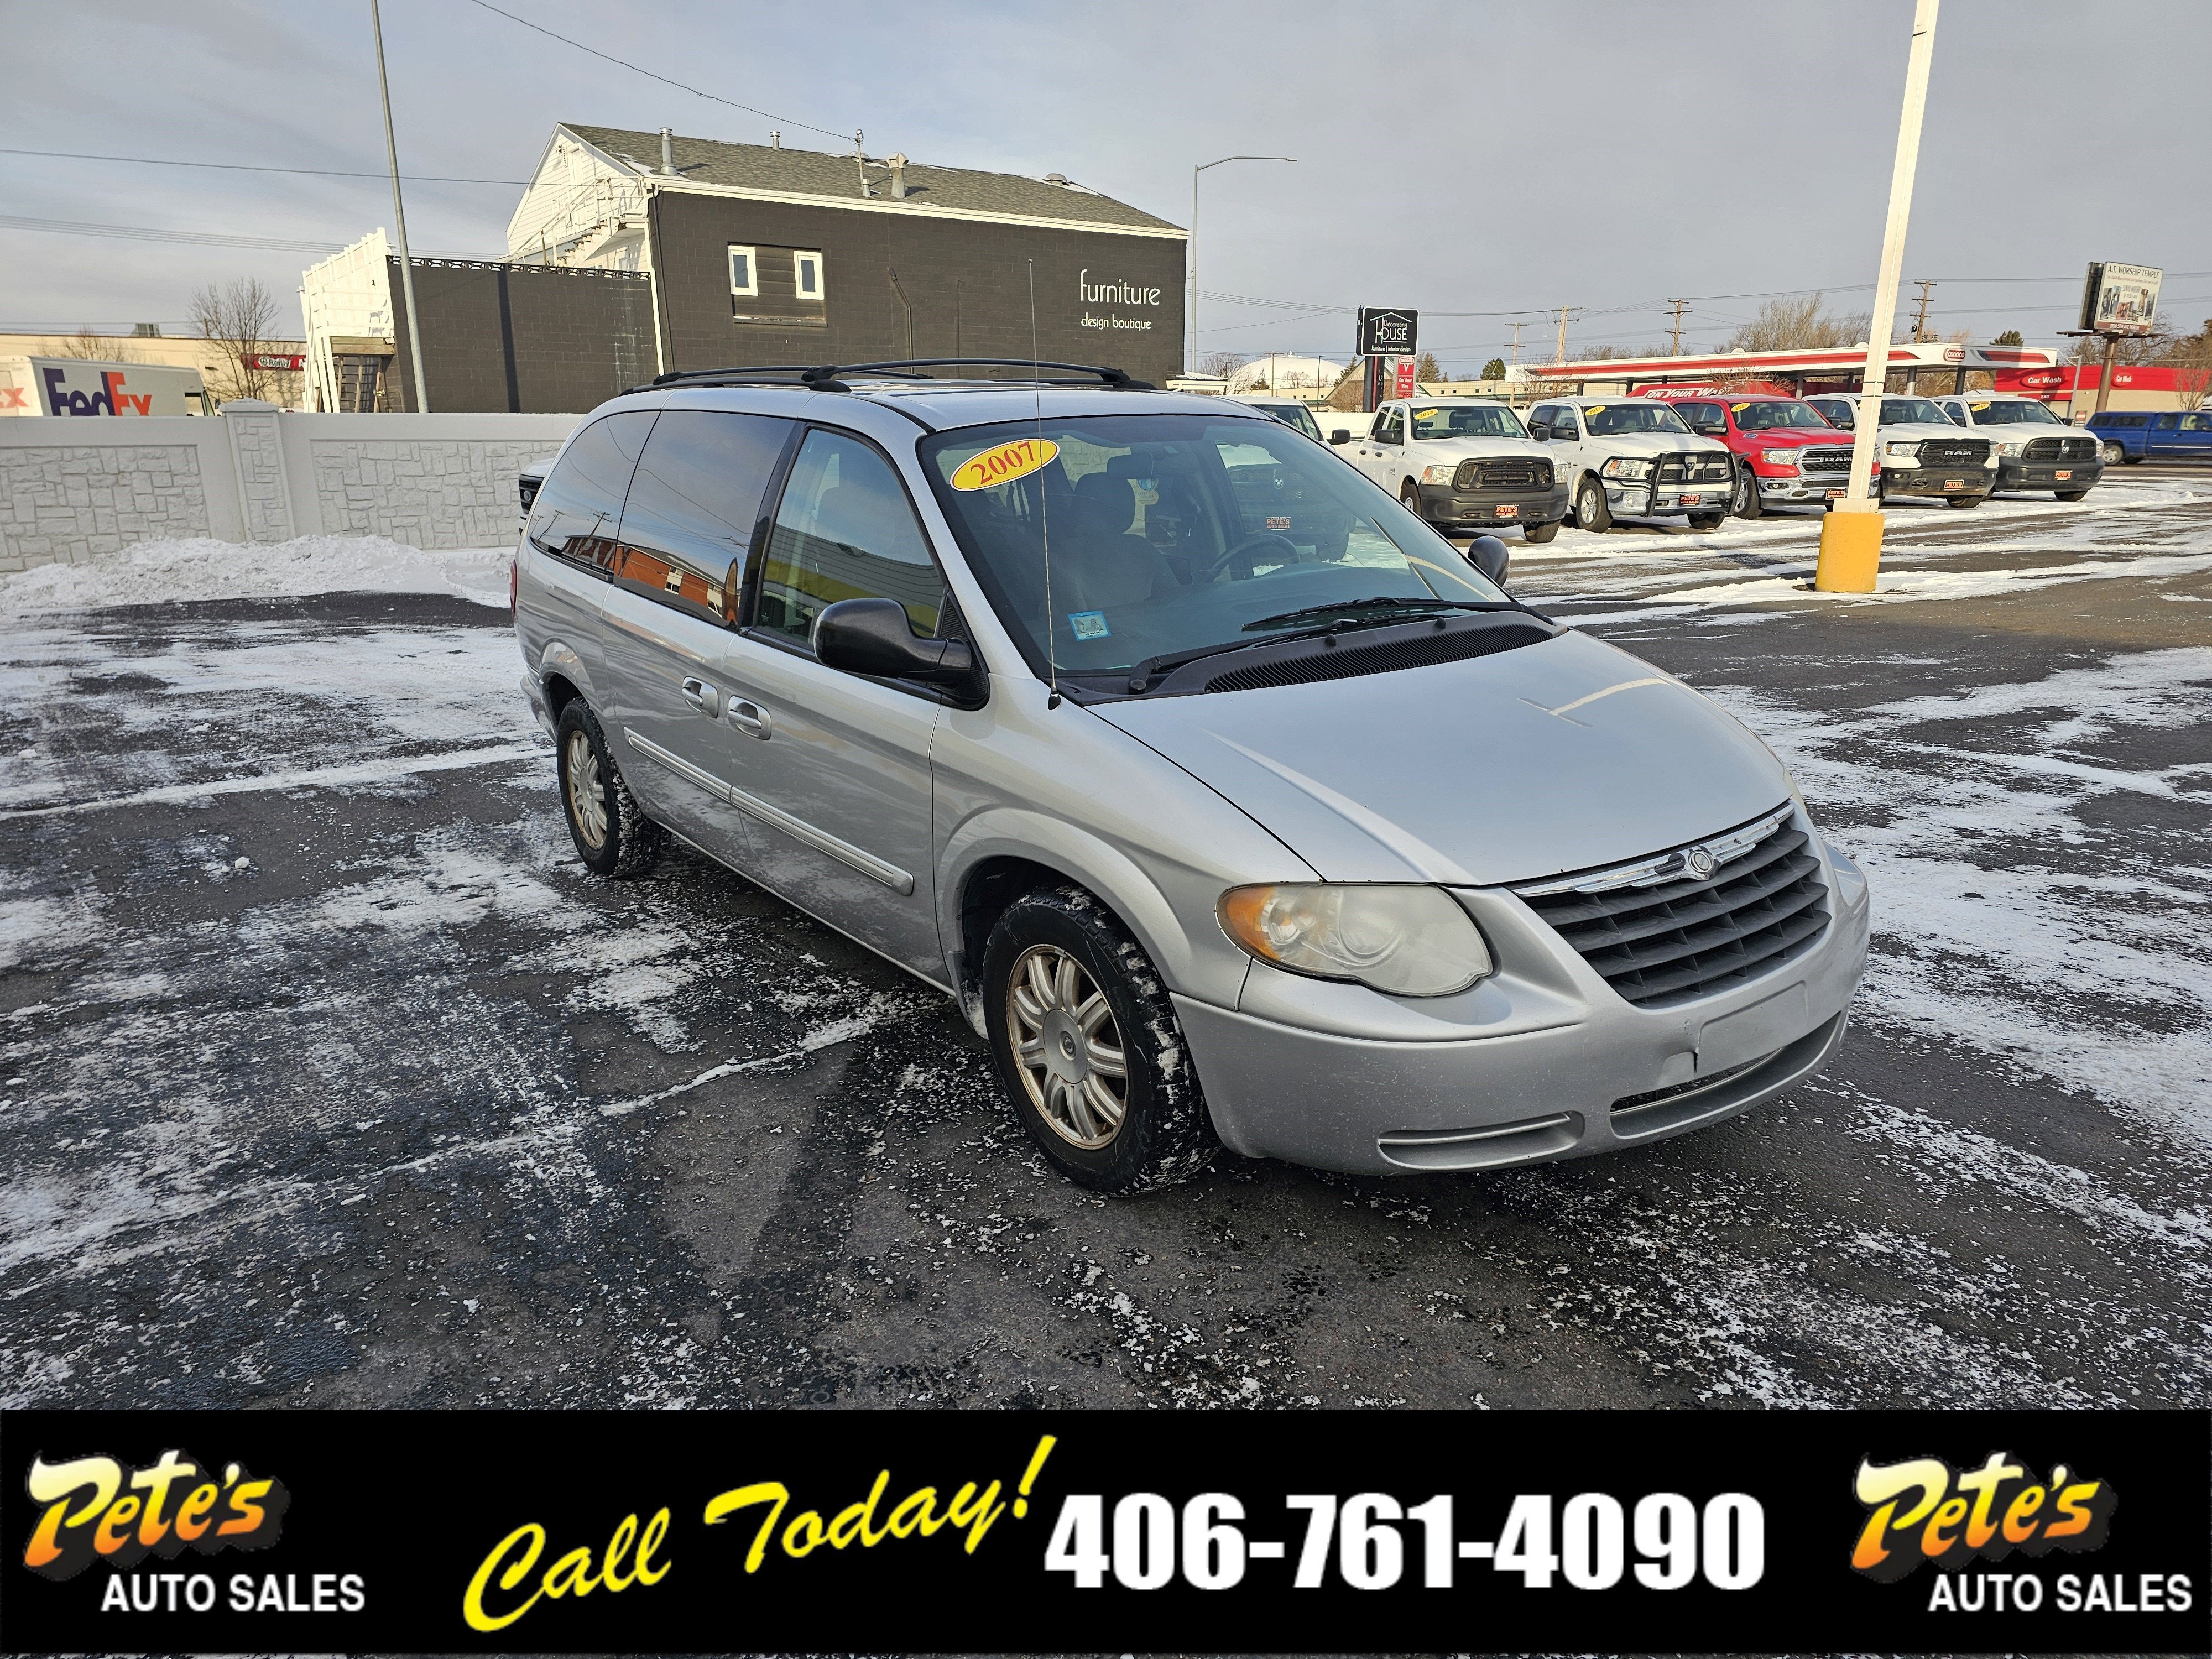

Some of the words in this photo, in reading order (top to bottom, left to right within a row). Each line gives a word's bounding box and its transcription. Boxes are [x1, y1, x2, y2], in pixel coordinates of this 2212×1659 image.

[2119, 267, 2141, 276] WORSHIP
[2142, 269, 2160, 279] TEMPLE
[1081, 269, 1161, 306] furniture
[1081, 312, 1109, 330] design
[1112, 314, 1151, 331] boutique
[1384, 319, 1407, 328] Decorating
[971, 441, 1034, 485] 2007
